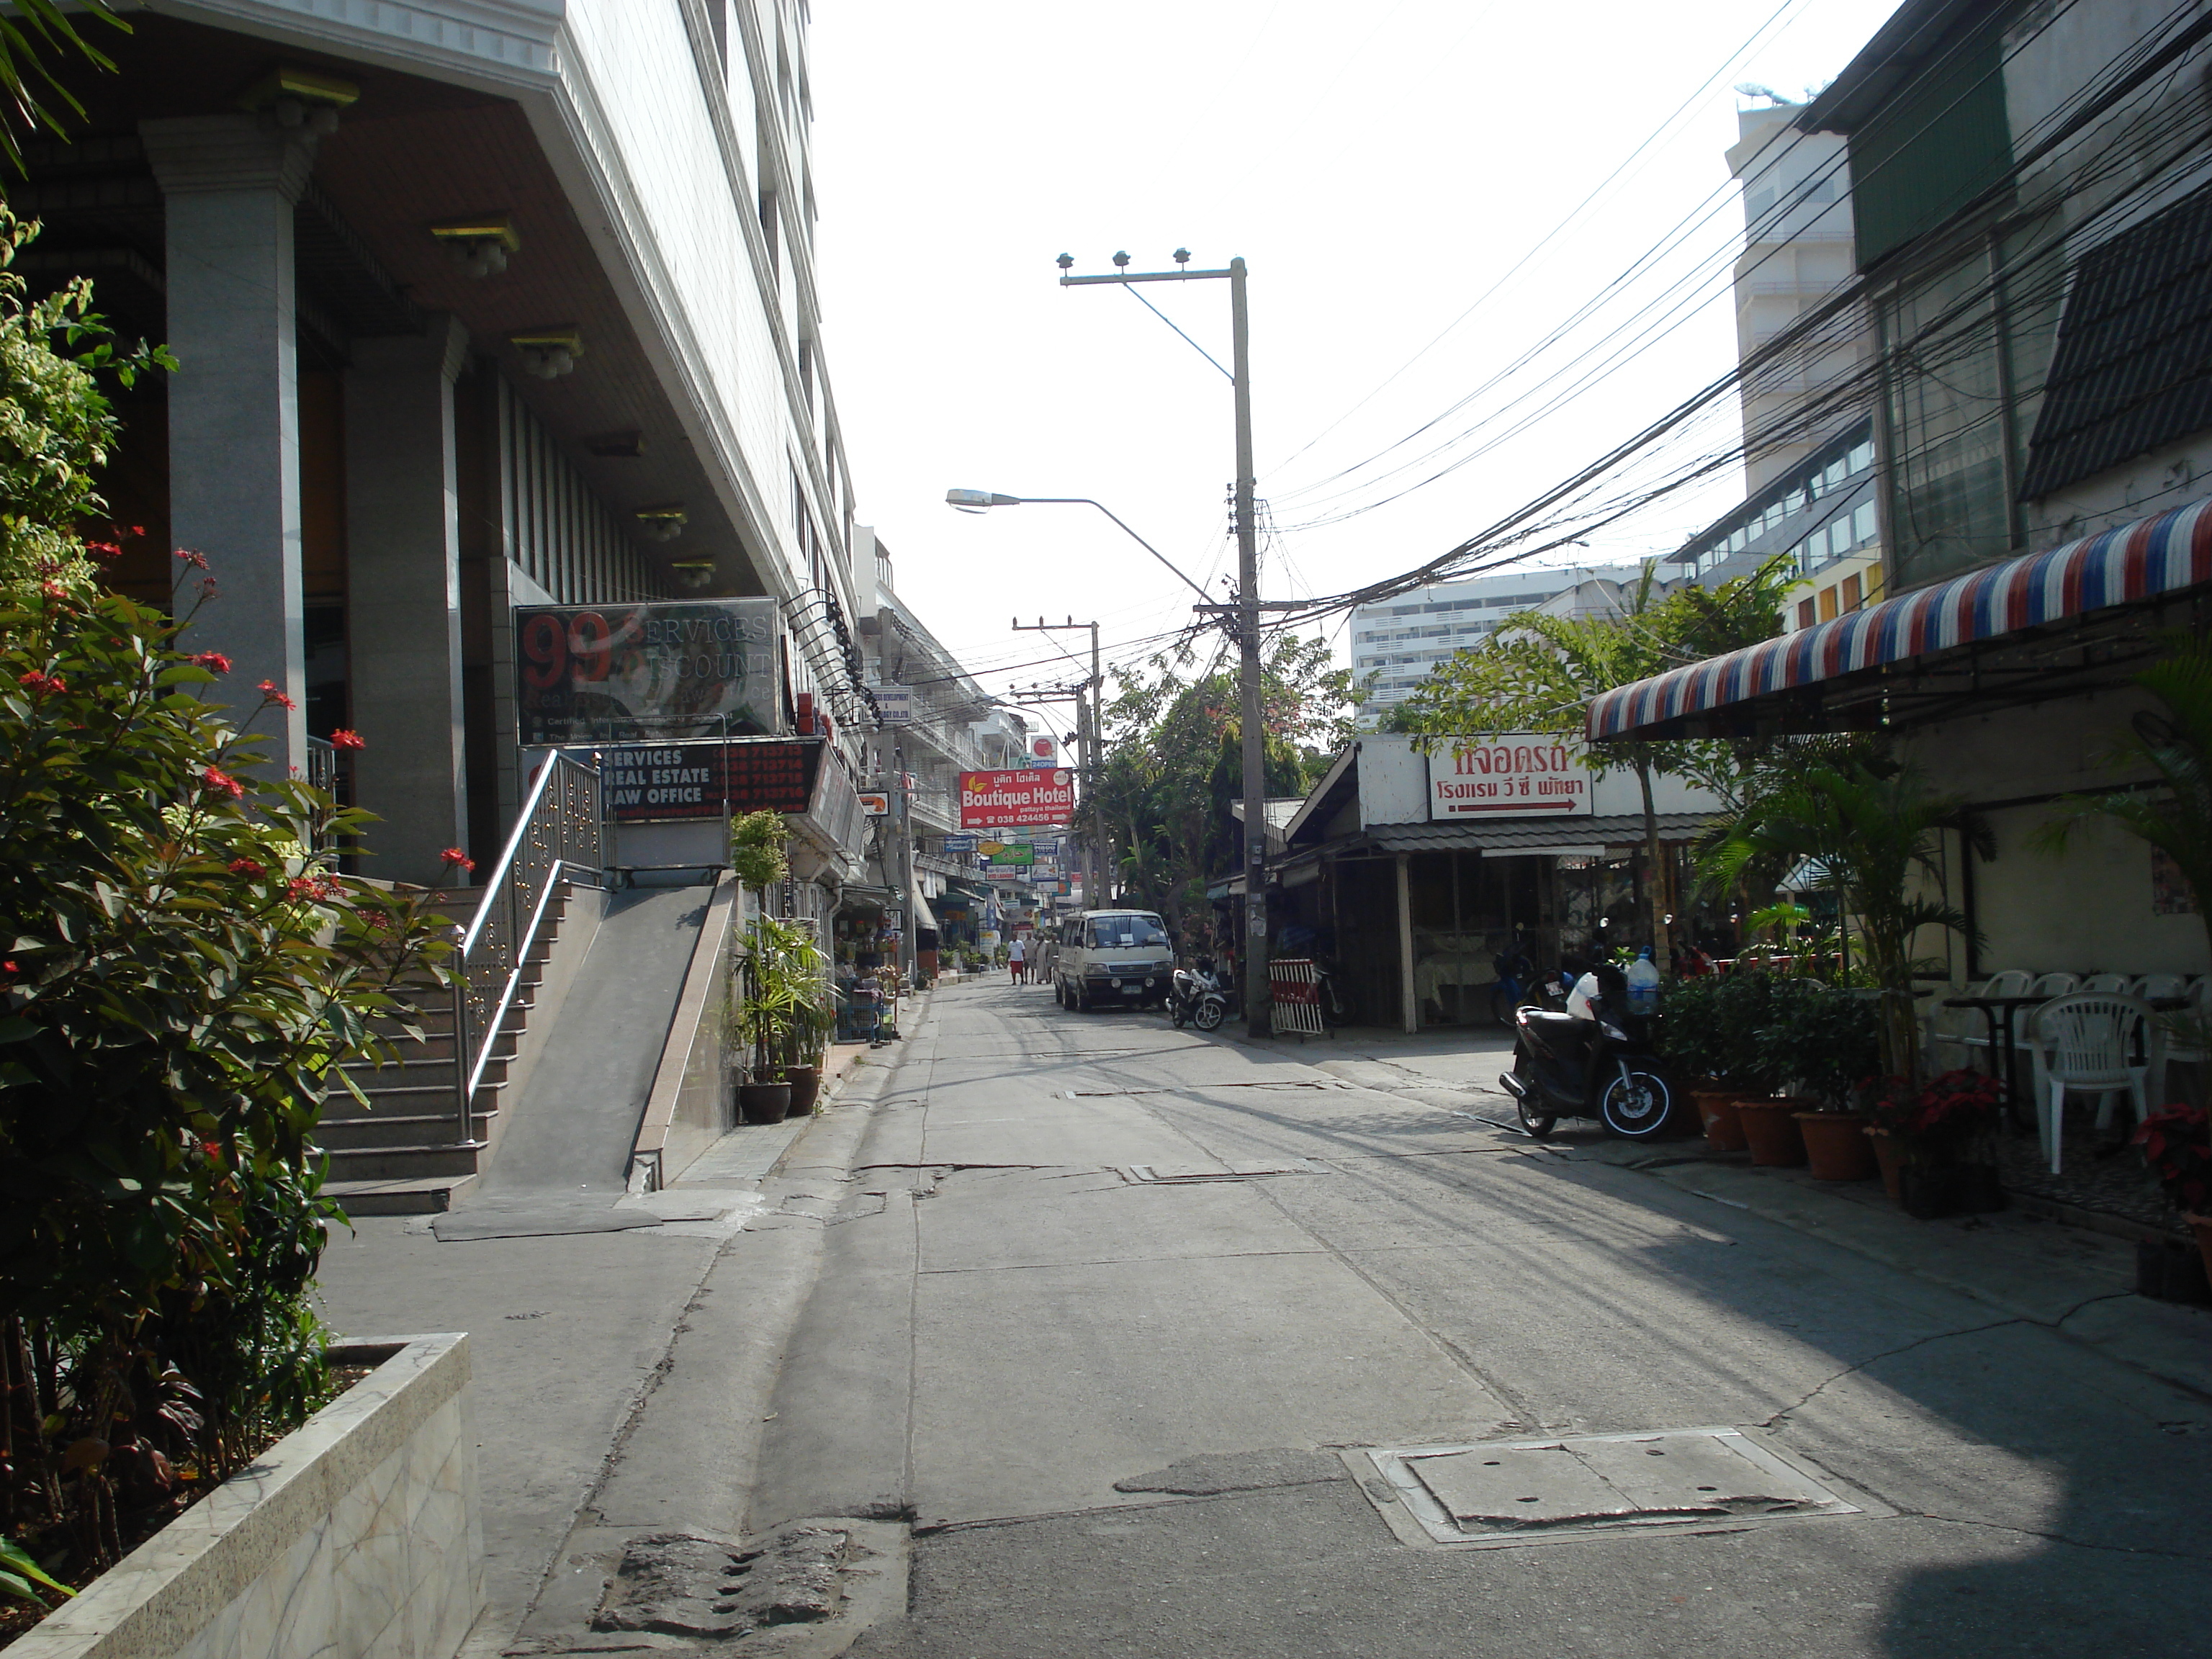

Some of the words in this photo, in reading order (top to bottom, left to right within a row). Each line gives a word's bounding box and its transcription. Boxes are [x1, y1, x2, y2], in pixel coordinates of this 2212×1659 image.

[523, 611, 612, 687] 99
[604, 750, 683, 767] SERVICES
[605, 770, 647, 786] REAL
[652, 768, 710, 784] ESTATE
[605, 789, 642, 805] LAW
[647, 787, 702, 804] OFFICE
[1437, 781, 1498, 799] โรงแรม
[1503, 776, 1514, 796] วี
[1538, 776, 1584, 796] พัทยา
[962, 789, 1031, 809] Boutique
[1033, 786, 1071, 804] Hotel
[997, 815, 1015, 824] 038
[1016, 814, 1050, 822] 424456
